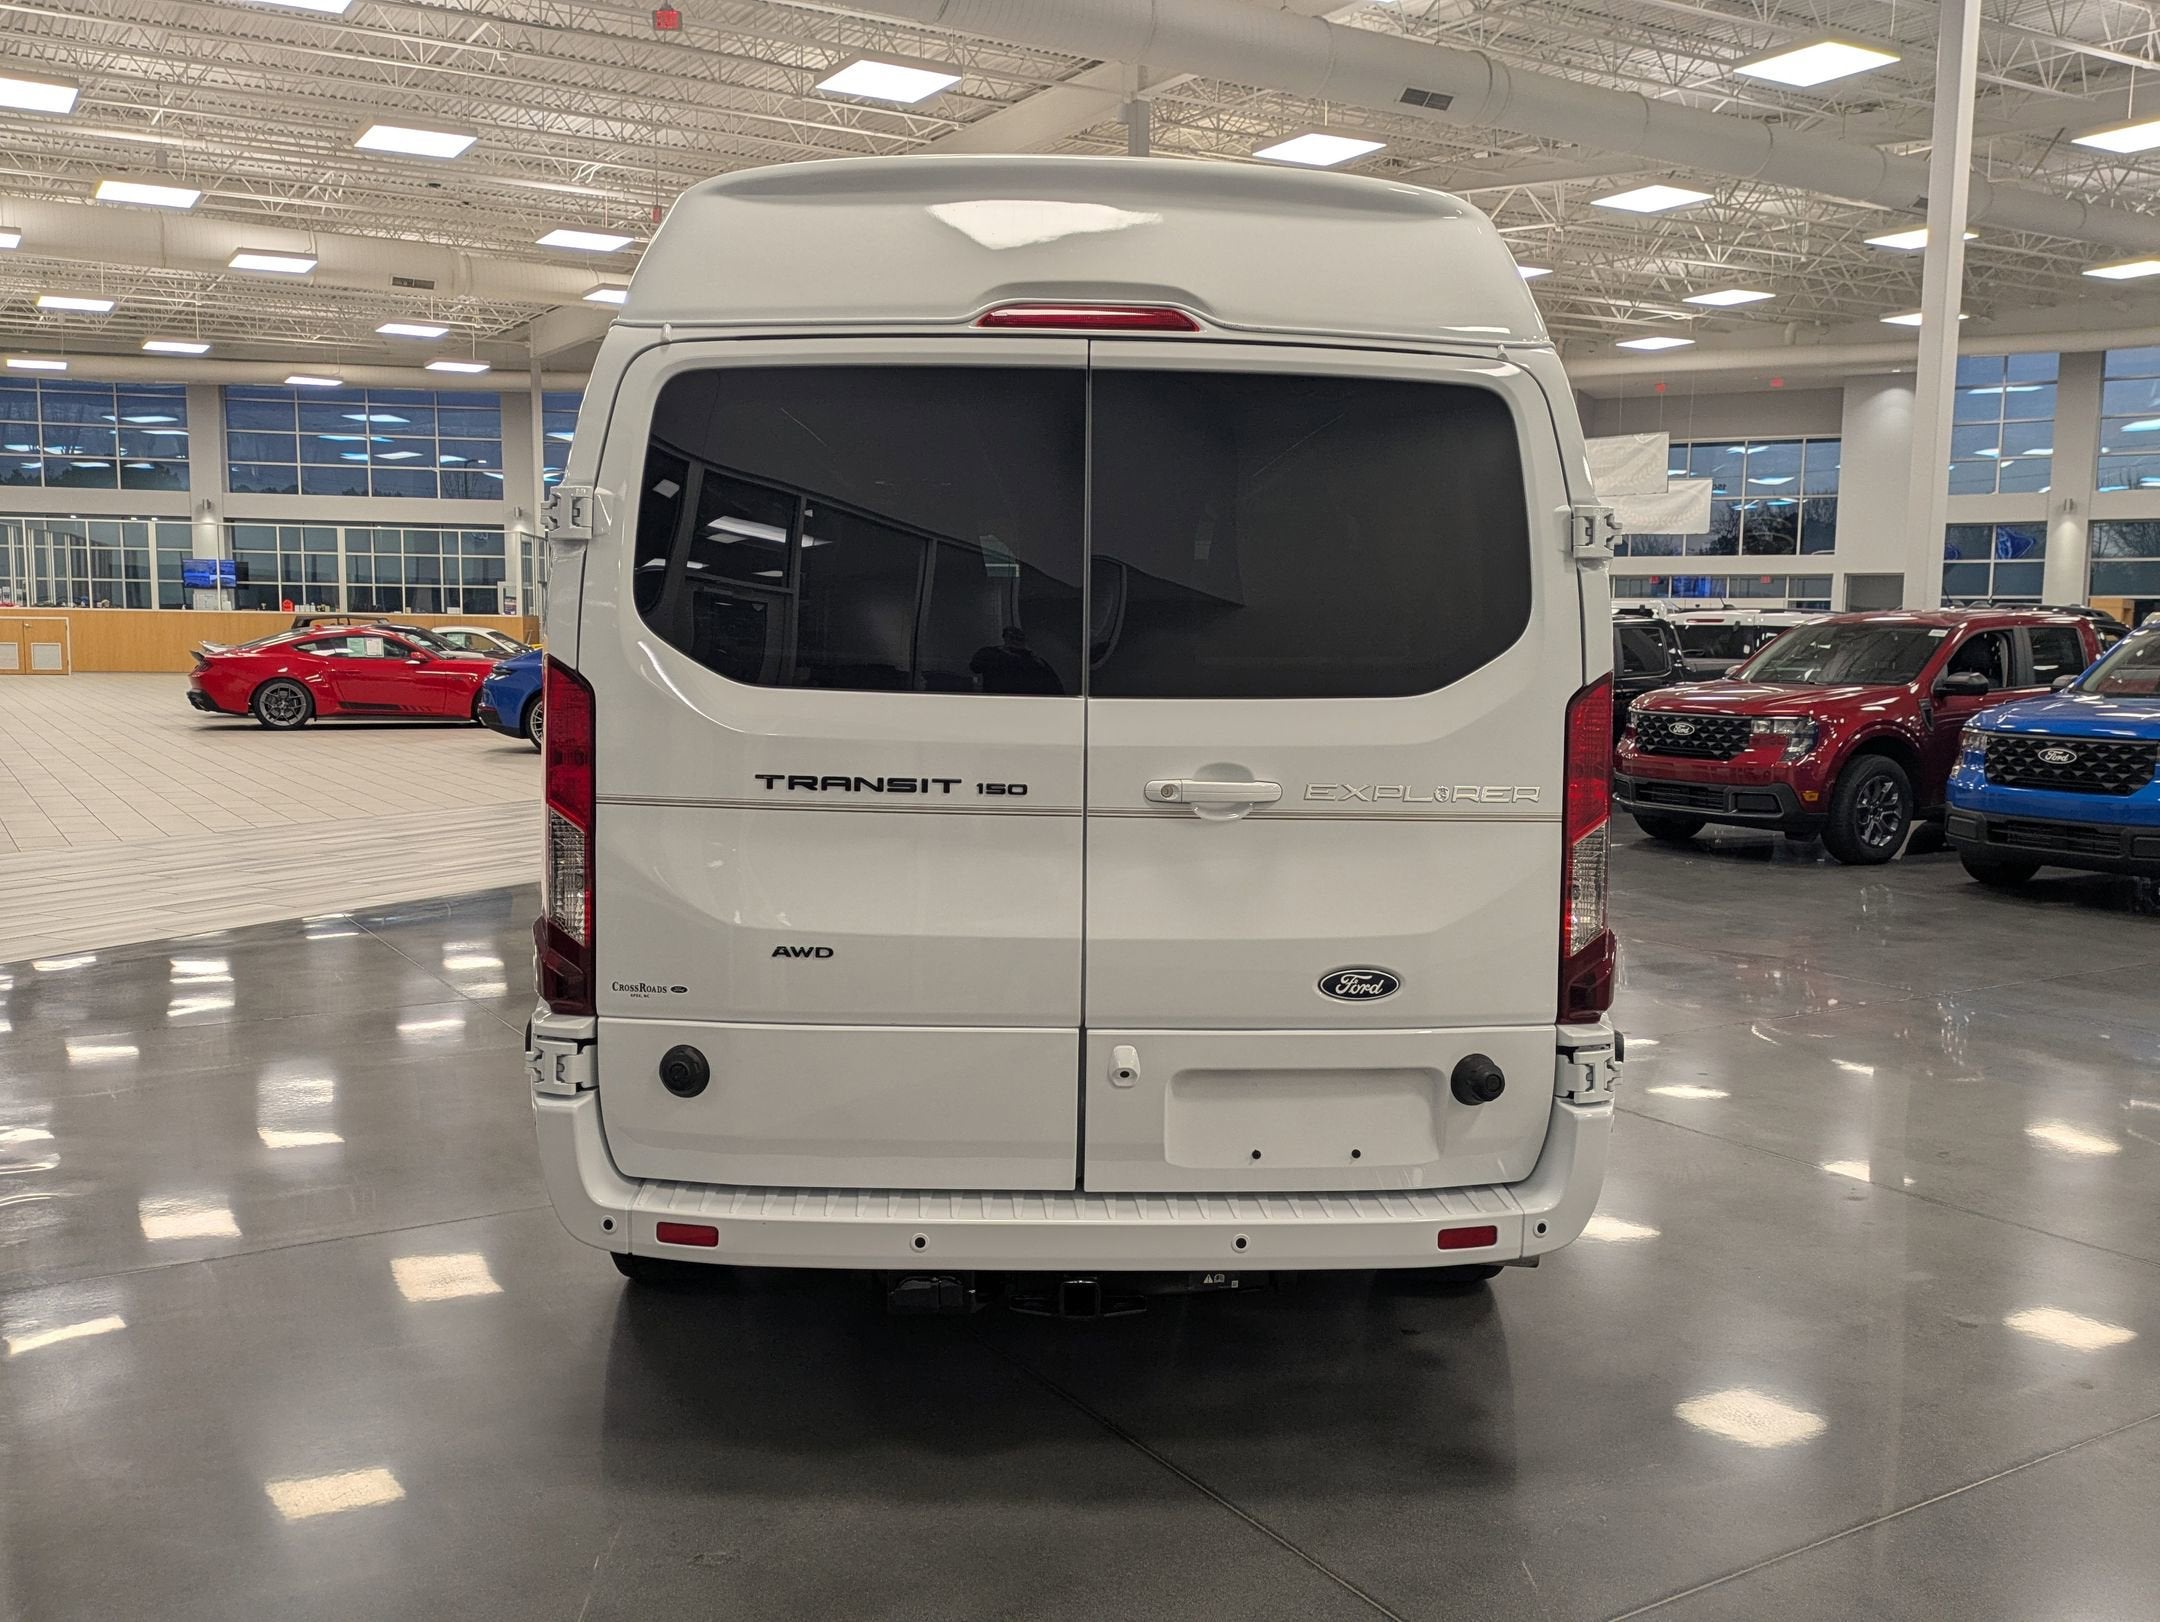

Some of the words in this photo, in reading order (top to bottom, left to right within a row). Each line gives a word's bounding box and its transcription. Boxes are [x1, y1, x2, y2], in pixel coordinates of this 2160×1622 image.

[754, 774, 962, 794] TRANSIT
[976, 782, 1028, 796] 150
[1303, 782, 1541, 803] EXPLORER
[771, 945, 834, 959] AWD
[1335, 974, 1384, 994] Ford
